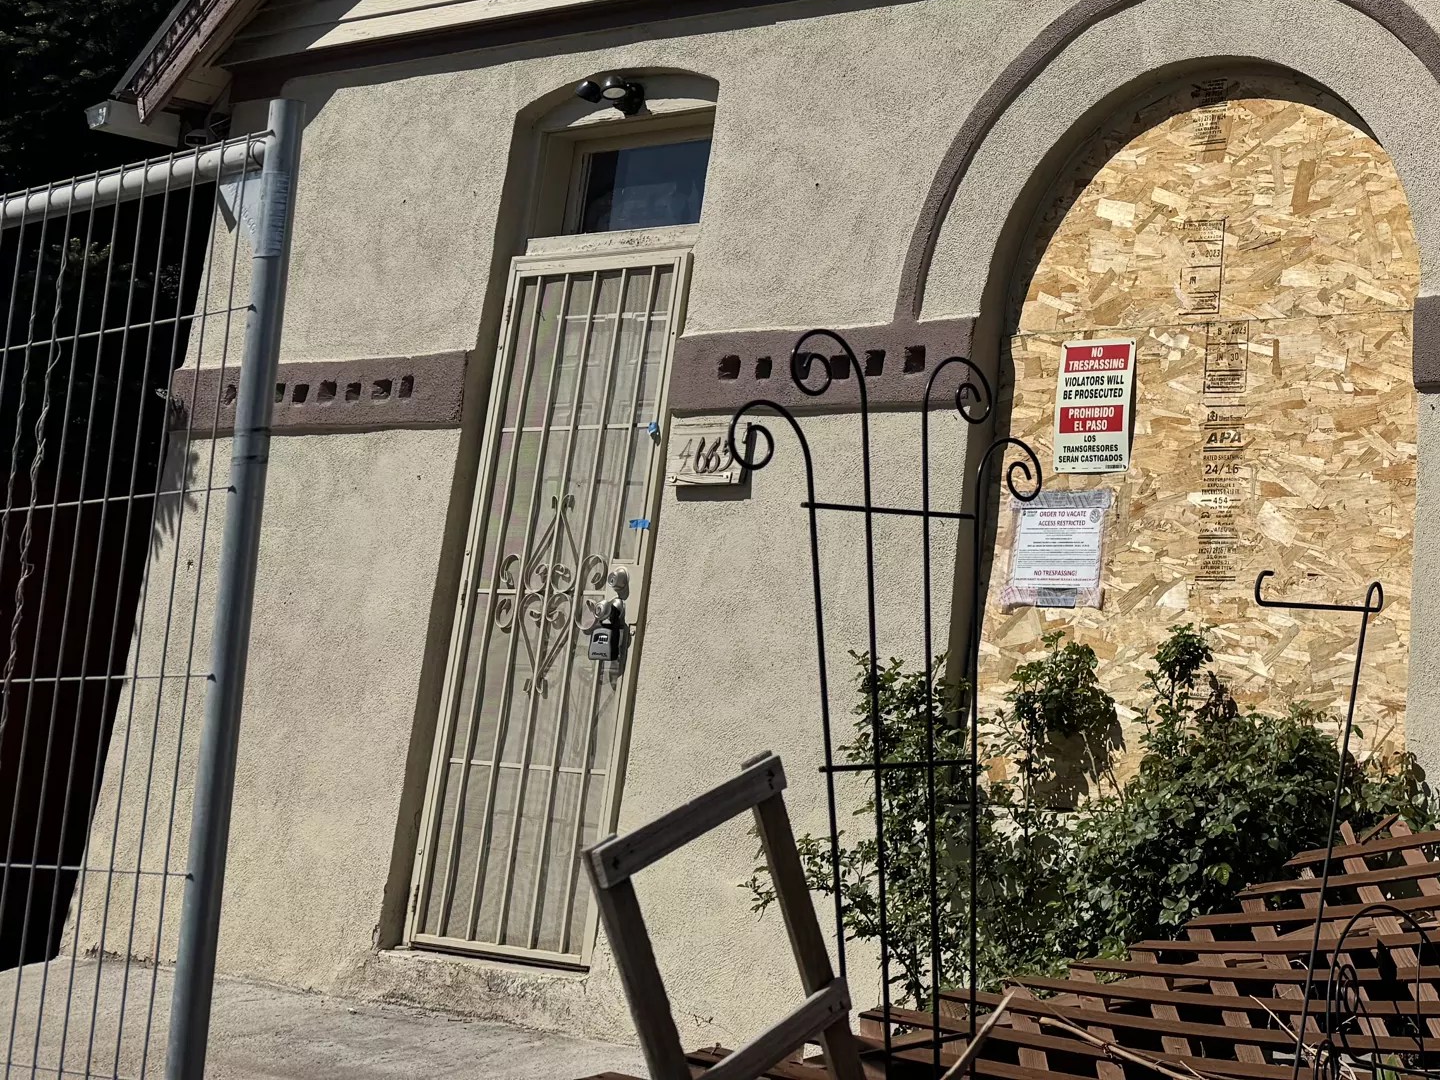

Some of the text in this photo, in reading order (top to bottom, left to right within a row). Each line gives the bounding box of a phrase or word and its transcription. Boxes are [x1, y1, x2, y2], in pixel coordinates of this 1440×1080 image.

[1205, 249, 1221, 258] 2023
[1231, 326, 1247, 335] 2023
[1091, 346, 1104, 358] NO
[1230, 352, 1239, 361] 30
[1068, 358, 1125, 371] TRESPASSING
[1064, 374, 1125, 387] VIOLATORS WILL
[1063, 388, 1124, 400] BE PROSECUTED
[1068, 406, 1115, 419] PROHIBIDO
[1074, 419, 1108, 431] EL PASO
[1083, 434, 1097, 443] LOS
[1206, 431, 1242, 444] APA
[1062, 444, 1119, 453] TRANSGRESORES
[1080, 453, 1123, 462] CASTIGADOS
[1205, 463, 1239, 476] 24/16
[1039, 510, 1058, 518] ORDER
[1058, 510, 1066, 518] TO
[1066, 510, 1087, 518] VACATE
